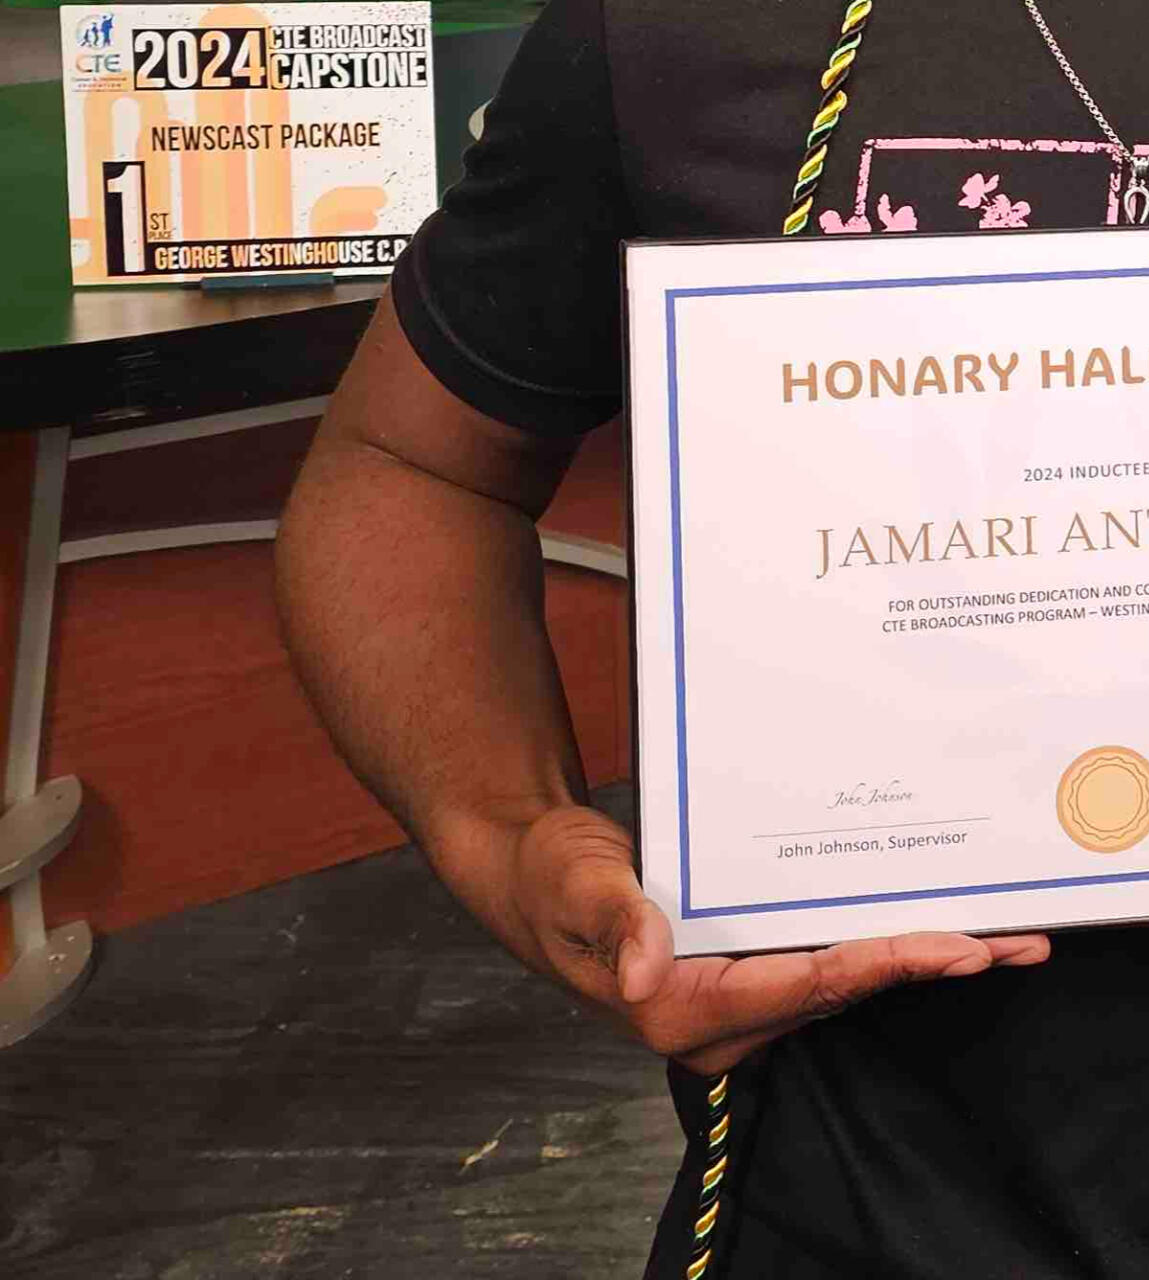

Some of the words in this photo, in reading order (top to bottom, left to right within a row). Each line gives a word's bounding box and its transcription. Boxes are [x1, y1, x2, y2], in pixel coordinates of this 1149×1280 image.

[270, 26, 307, 49] CTE
[312, 24, 427, 49] BROADCAST
[76, 54, 121, 73] CTE
[134, 30, 265, 89] 2024
[270, 52, 427, 89] CAPSTONE
[152, 125, 272, 151] NEWSCAST
[281, 122, 380, 149] PACKAGE
[107, 165, 146, 273] 1
[150, 213, 168, 230] ST
[155, 246, 228, 270] GEORGE
[231, 240, 375, 268] WESTINGHOUSE
[783, 352, 1019, 402] HONARY
[1024, 468, 1063, 482] 2024
[816, 515, 1038, 579] JAMARI
[888, 600, 915, 613] FOR
[918, 592, 1016, 611] OUTSTANDING
[1019, 586, 1099, 603] DEDICATION
[1103, 585, 1132, 598] AND
[882, 619, 906, 633] CTE
[911, 612, 1015, 631] BROADCASTING
[1018, 607, 1086, 623] PROGRAM
[777, 843, 813, 859] John
[817, 837, 884, 854] Johnson,
[887, 831, 967, 851] Supervisor
